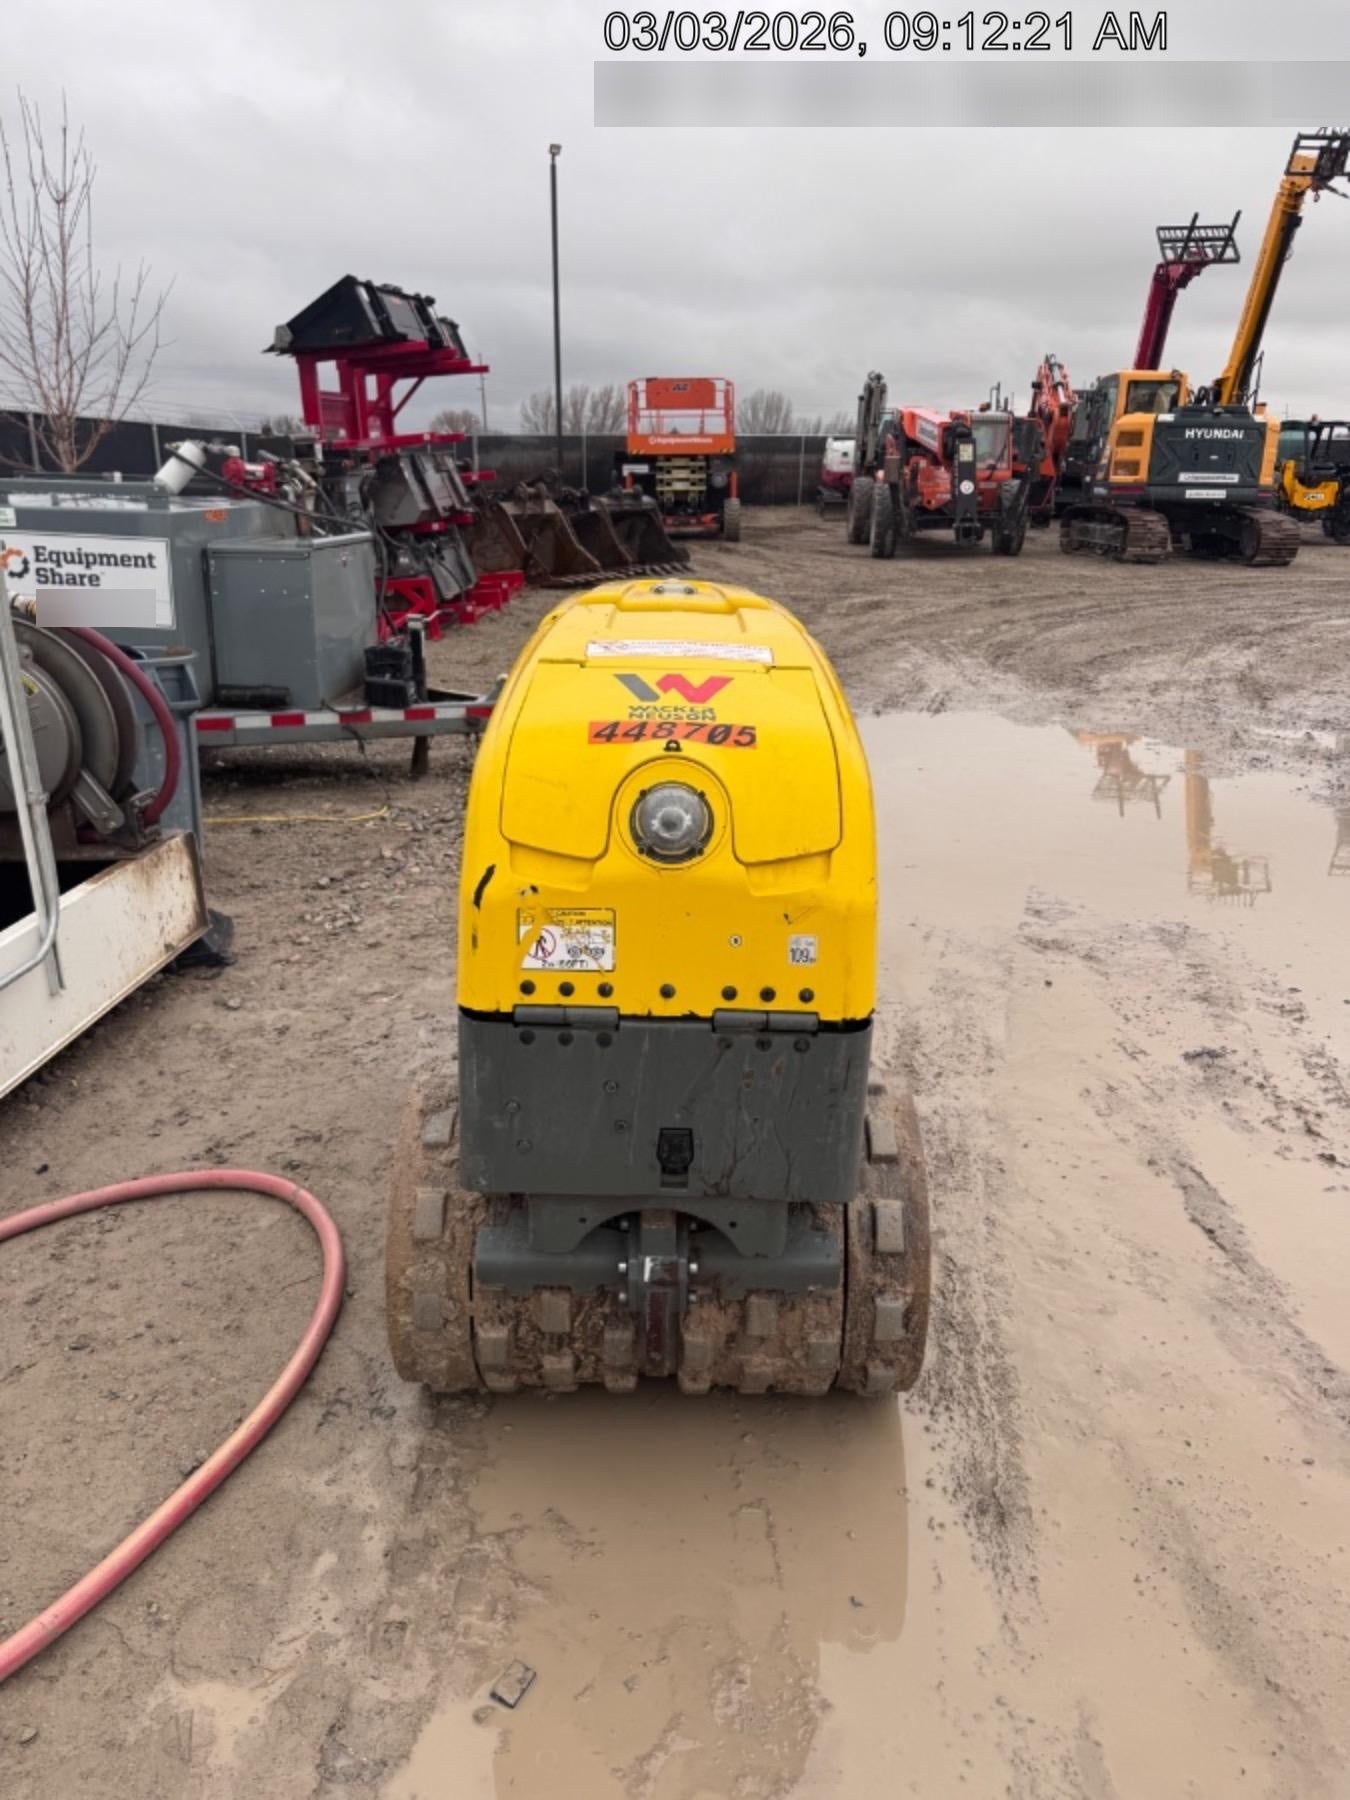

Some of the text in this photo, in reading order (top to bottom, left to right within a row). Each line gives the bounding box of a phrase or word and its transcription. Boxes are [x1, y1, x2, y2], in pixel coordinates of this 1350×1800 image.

[1185, 428, 1245, 440] HYUNDAI
[33, 545, 156, 569] Equipment
[36, 568, 101, 587] Share
[593, 721, 757, 747] 448705
